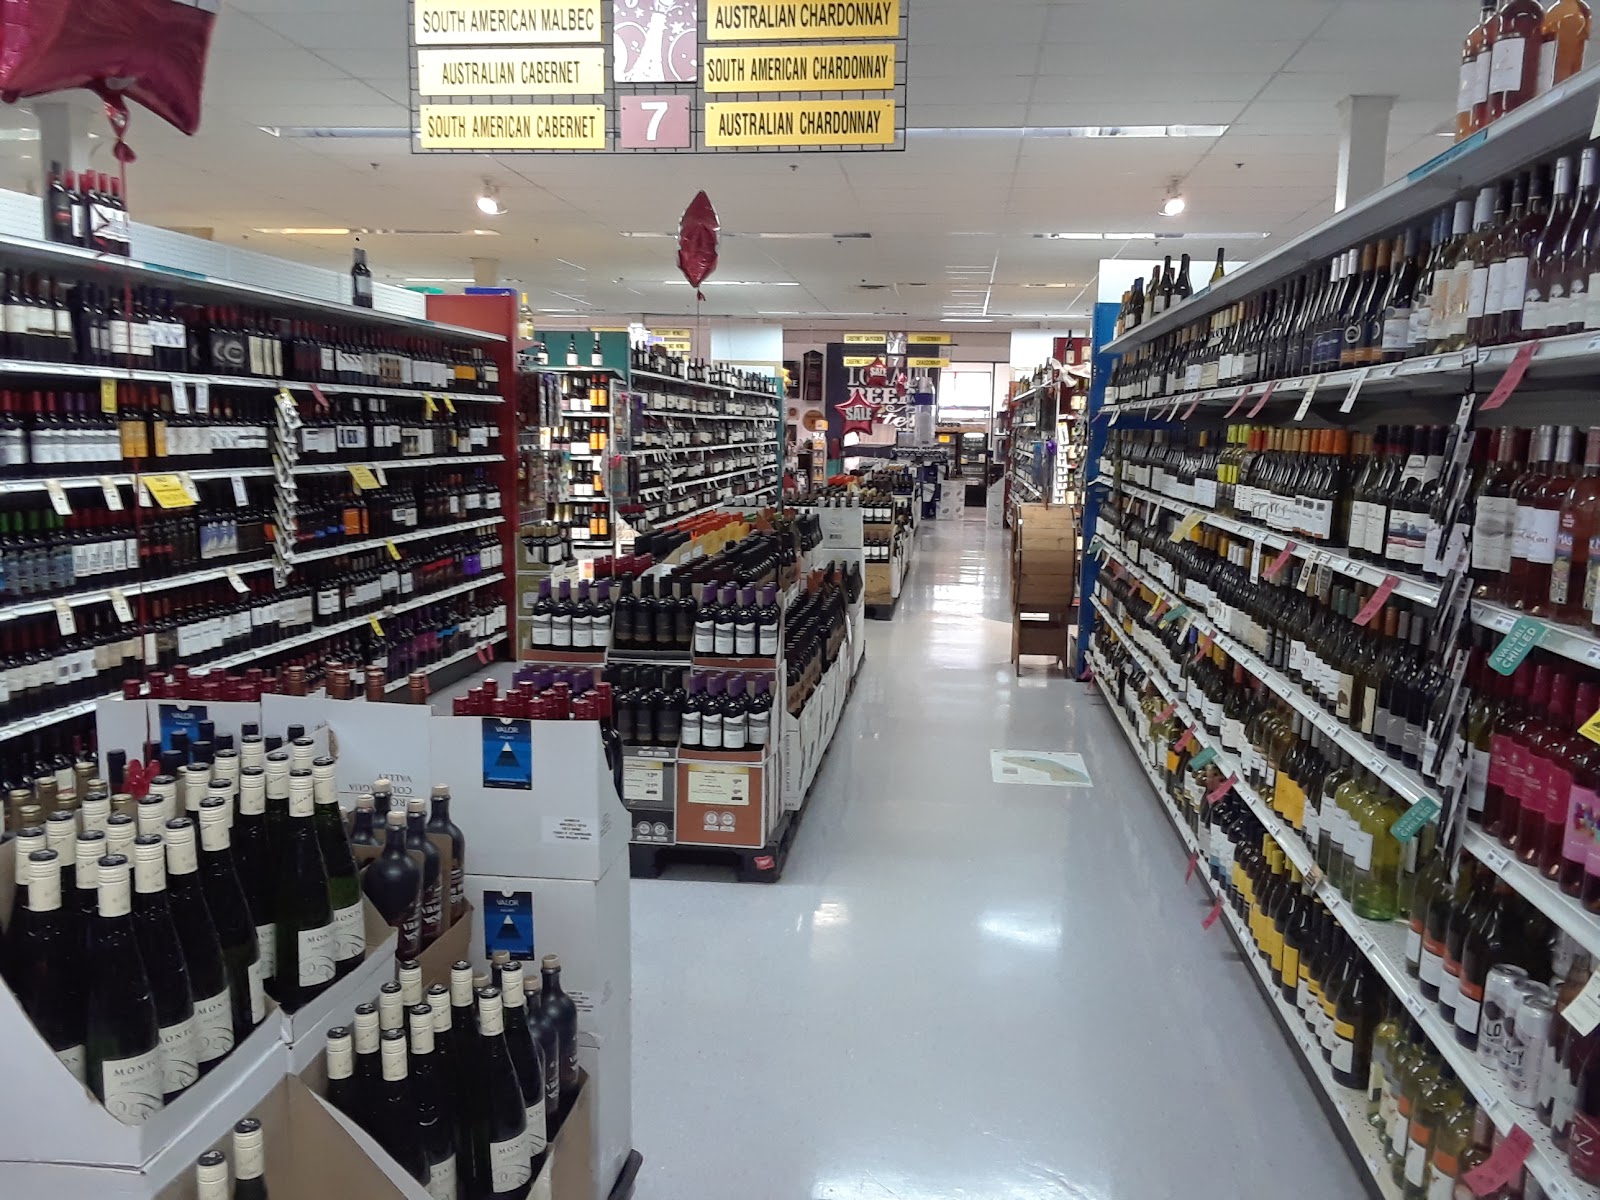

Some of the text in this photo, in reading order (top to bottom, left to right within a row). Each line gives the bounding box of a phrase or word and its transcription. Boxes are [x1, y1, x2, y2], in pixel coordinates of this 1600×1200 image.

[423, 8, 594, 33] SOUTH AMERICAN MALBEC
[715, 2, 891, 29] AUSTRALIAN CHARDONNAY
[442, 61, 580, 85] AUSTRALIAN CABERNET
[708, 55, 888, 82] SOUTH AMERICAN CHARDONNAY
[428, 115, 596, 138] SOUTH AMERICAN CABERNET
[641, 101, 669, 141] 7
[719, 110, 881, 136] AUSTRALIAN CHARDONNAY
[870, 366, 887, 377] SALE
[892, 357, 900, 366] 7
[845, 407, 872, 421] SALE
[1495, 624, 1528, 663] AVAILABLE
[1502, 627, 1536, 668] CHILLED
[1400, 806, 1432, 838] CHILLED
